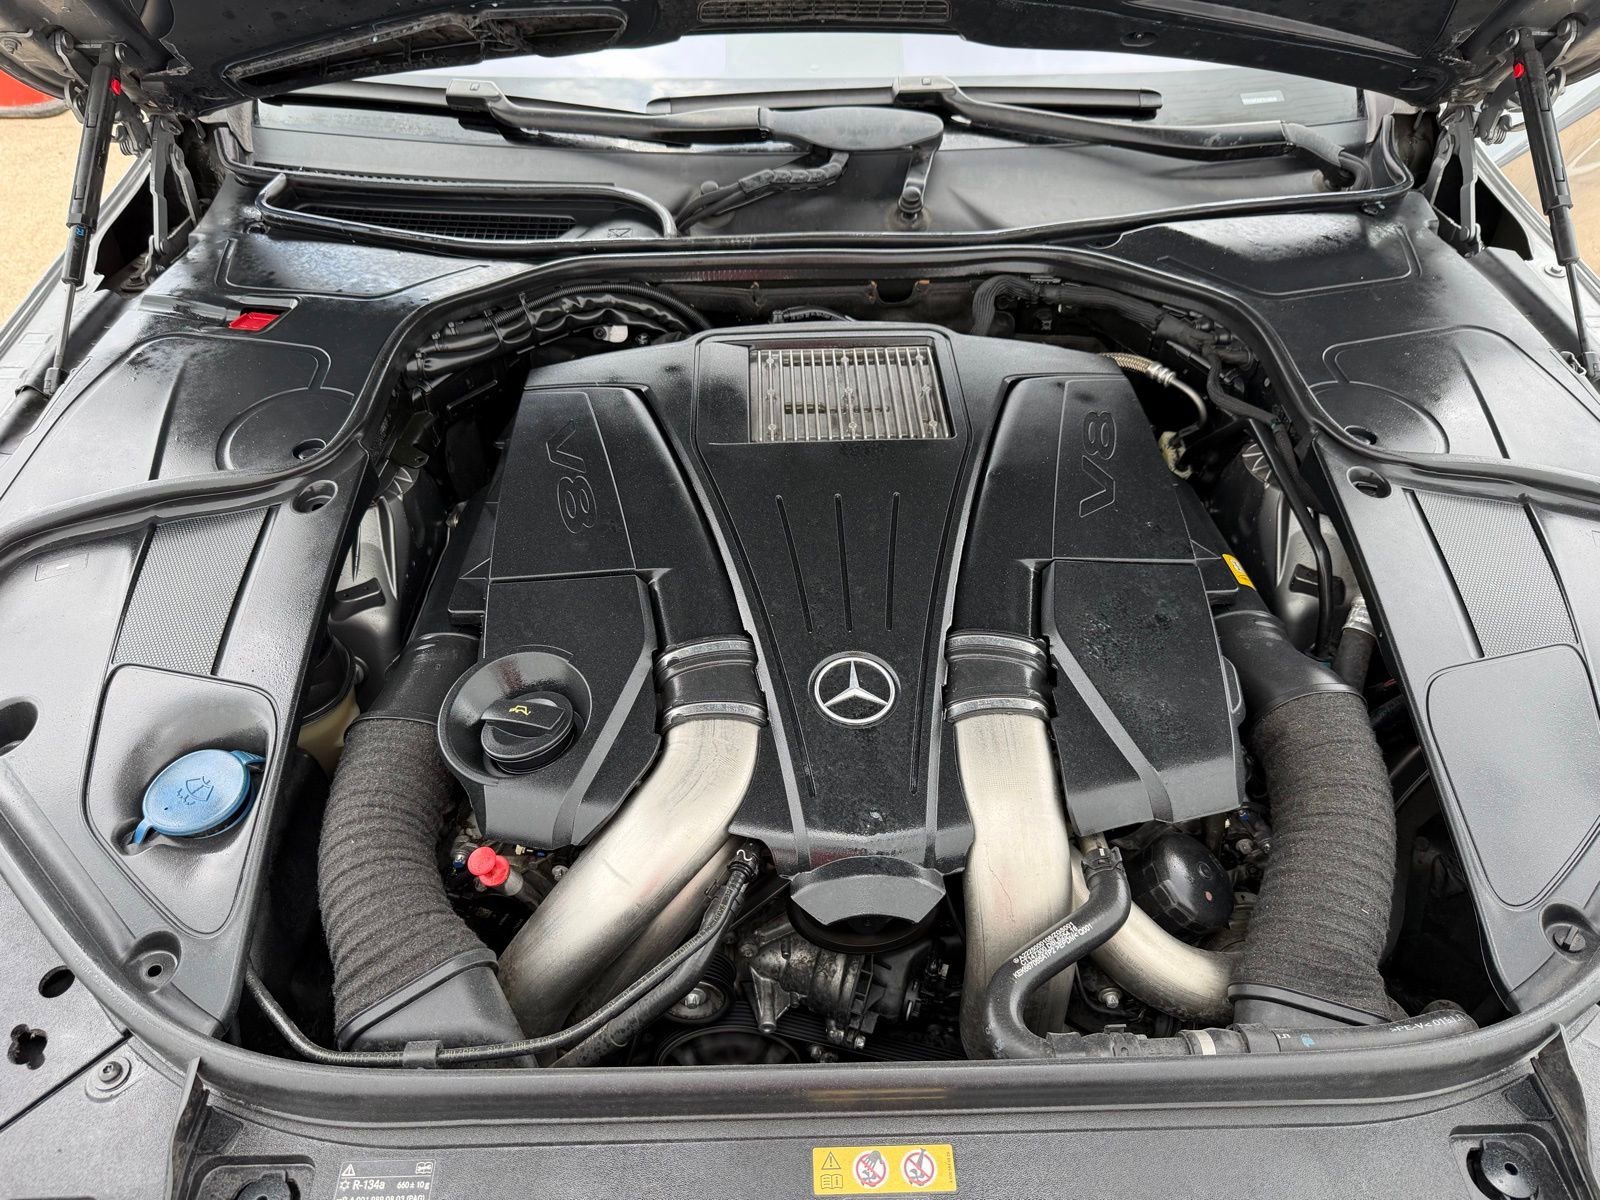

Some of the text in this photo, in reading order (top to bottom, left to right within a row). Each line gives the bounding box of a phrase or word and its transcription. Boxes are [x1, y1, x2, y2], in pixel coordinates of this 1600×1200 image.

[545, 418, 598, 534] V8
[1078, 410, 1117, 518] V8
[352, 1180, 385, 1190] R-134a
